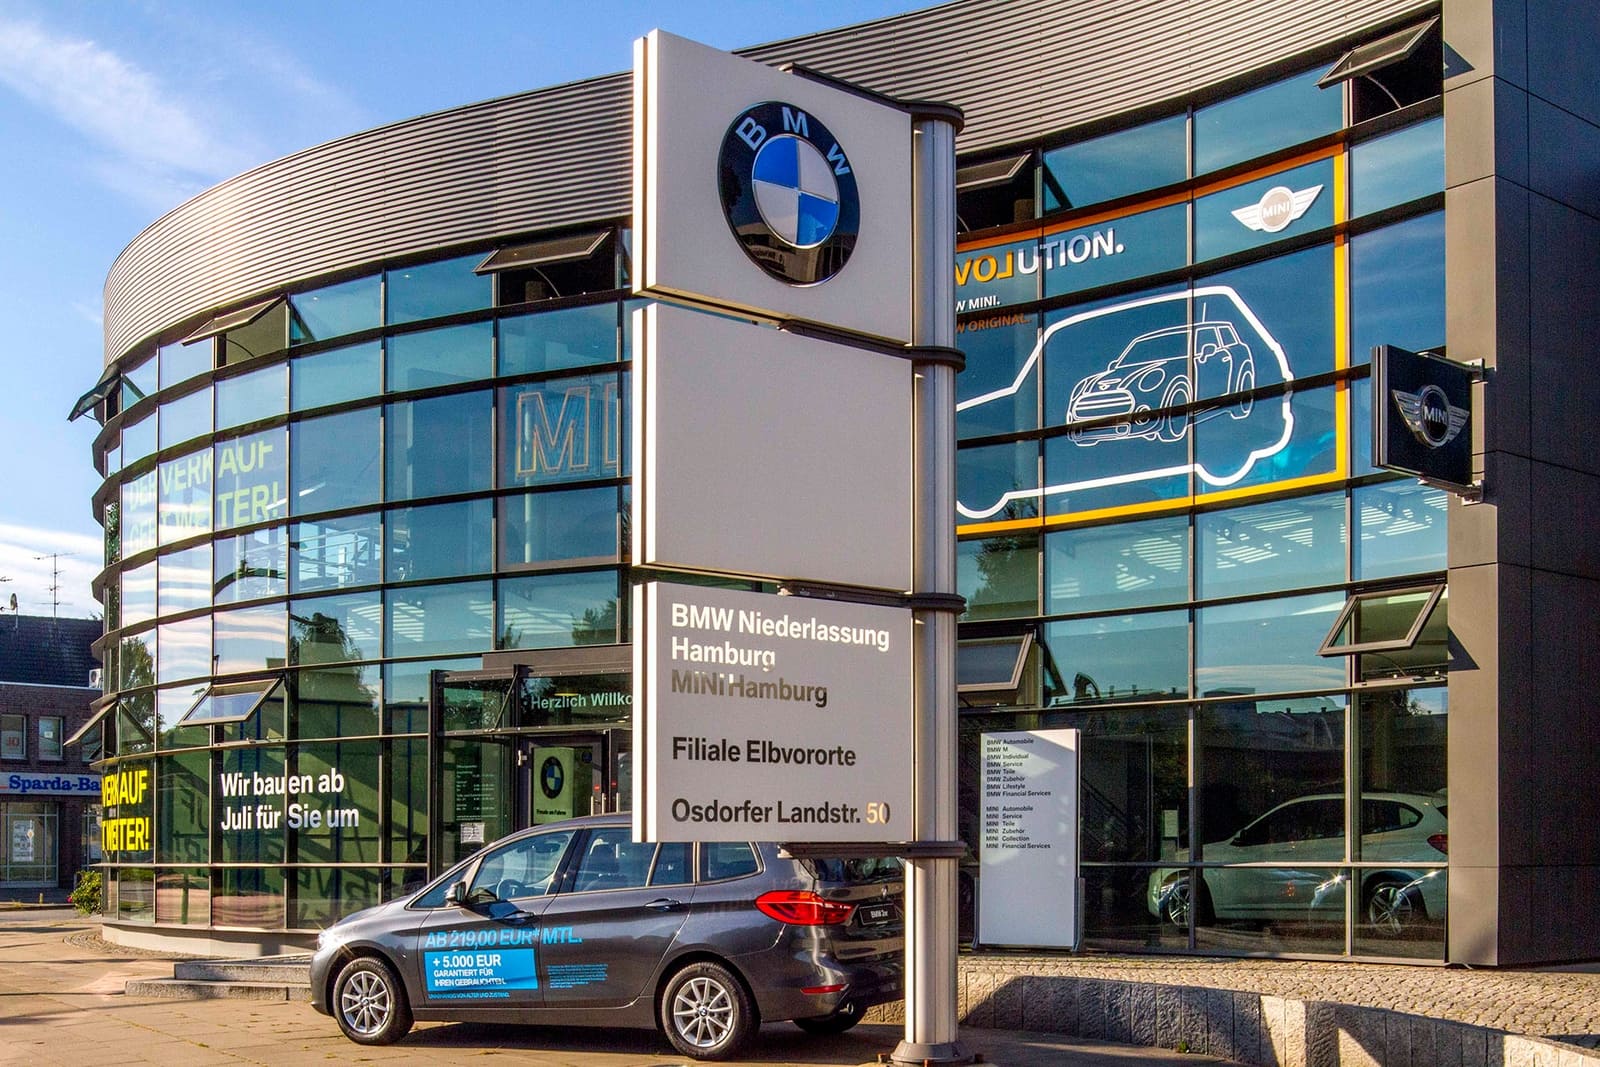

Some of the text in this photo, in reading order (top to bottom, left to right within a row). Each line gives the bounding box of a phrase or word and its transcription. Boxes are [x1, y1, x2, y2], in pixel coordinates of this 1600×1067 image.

[736, 106, 850, 176] BMW
[1262, 201, 1290, 218] MINI
[968, 295, 1000, 310] MINI.
[968, 312, 1032, 332] ORIGINAL.
[672, 603, 890, 652] BMW Niederlassung
[672, 636, 775, 672] Hamburg
[531, 693, 586, 710] Herzlich
[672, 669, 828, 708] MINI Hamburg
[672, 736, 856, 766] Filiale Elbvororte
[221, 768, 344, 796] Wir bauen ab
[221, 803, 359, 830] Juli für Sie um
[672, 798, 890, 824] Osdorfer Landstr. 50
[425, 932, 448, 948] AB
[450, 930, 496, 950] 219,00
[543, 926, 582, 944] MTL.
[434, 967, 494, 977] GARANTIERT FÜR
[443, 955, 474, 968] 5.000
[476, 954, 502, 967] EUR
